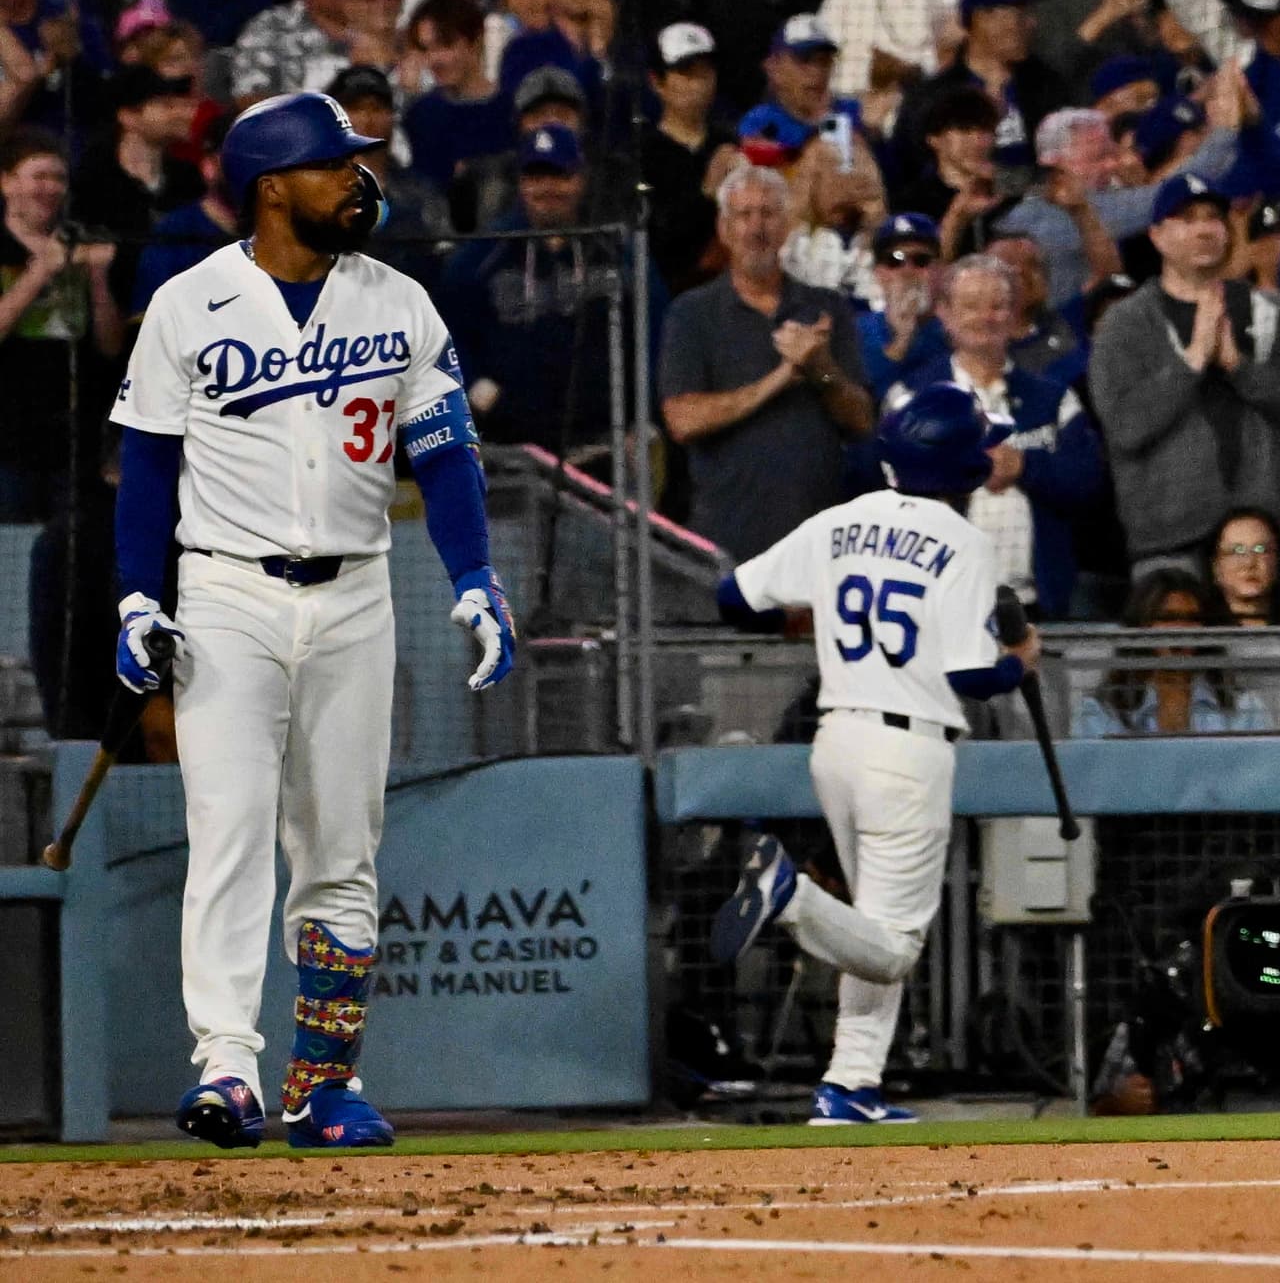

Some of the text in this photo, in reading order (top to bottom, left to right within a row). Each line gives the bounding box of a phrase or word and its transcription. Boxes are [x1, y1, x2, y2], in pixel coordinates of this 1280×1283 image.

[197, 323, 411, 419] Dodgers
[831, 523, 956, 580] BRANDEN
[836, 574, 926, 668] 95
[438, 941, 458, 964] &
[471, 936, 598, 963] CASINO
[431, 968, 574, 997] MANUEL
